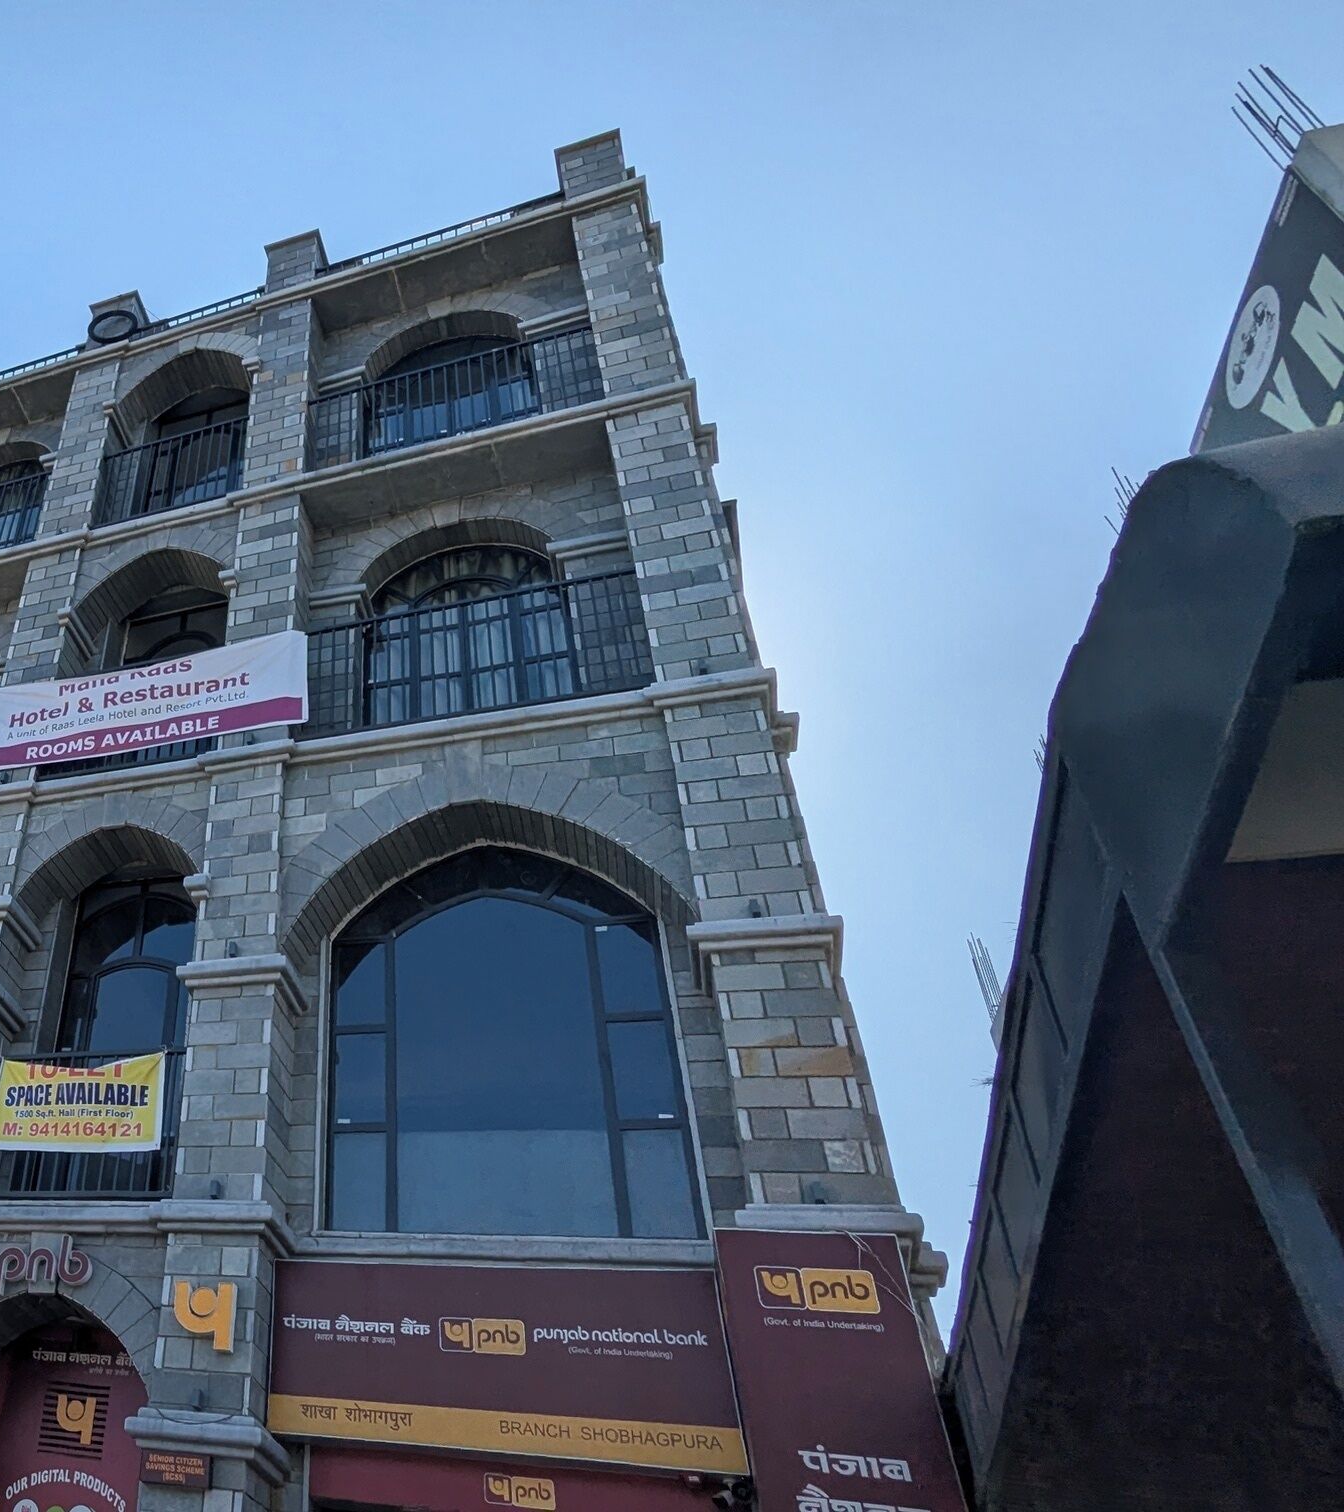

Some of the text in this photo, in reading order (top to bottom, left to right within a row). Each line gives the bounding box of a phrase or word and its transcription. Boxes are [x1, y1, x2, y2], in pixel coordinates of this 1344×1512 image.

[9, 671, 250, 728] Hotel & Restaurant
[7, 731, 13, 740] A
[16, 727, 37, 739] unit
[40, 724, 49, 734] of
[51, 720, 75, 733] Raas
[108, 707, 137, 721] Hotel
[140, 704, 161, 717] and
[166, 699, 201, 713] Resort
[26, 715, 220, 760] ROOMS AVAILABLE
[5, 1082, 150, 1107] SPACE AVAILABLE
[14, 1110, 33, 1118] 1500
[58, 1109, 75, 1117] Hall
[77, 1108, 102, 1118] (First
[105, 1109, 133, 1119] Floor)
[2, 1121, 143, 1137] M: 9414164121
[809, 1275, 870, 1305] pnb
[283, 1313, 330, 1331] पंजाब
[335, 1314, 395, 1334] नैशनल
[400, 1317, 431, 1336] बैंक
[477, 1327, 521, 1349] pnb
[533, 1325, 589, 1344] punjab
[591, 1328, 662, 1344] national
[663, 1328, 708, 1346] bank
[793, 1319, 801, 1327] of
[804, 1319, 825, 1328] India
[828, 1320, 884, 1333] Undertaking)
[594, 1347, 602, 1355] of
[603, 1348, 622, 1356] India
[301, 1403, 723, 1451] शाखा शोभागपुरा BRANCH SHOBHAGPURA
[145, 1462, 205, 1476] SAVINGS SCHEME
[148, 1453, 203, 1467] SENIOR CITIZEN
[798, 1444, 913, 1482] पंजाब
[6, 1469, 126, 1512] OUR DIGITAL PRODUCTS
[515, 1482, 551, 1503] pnb
